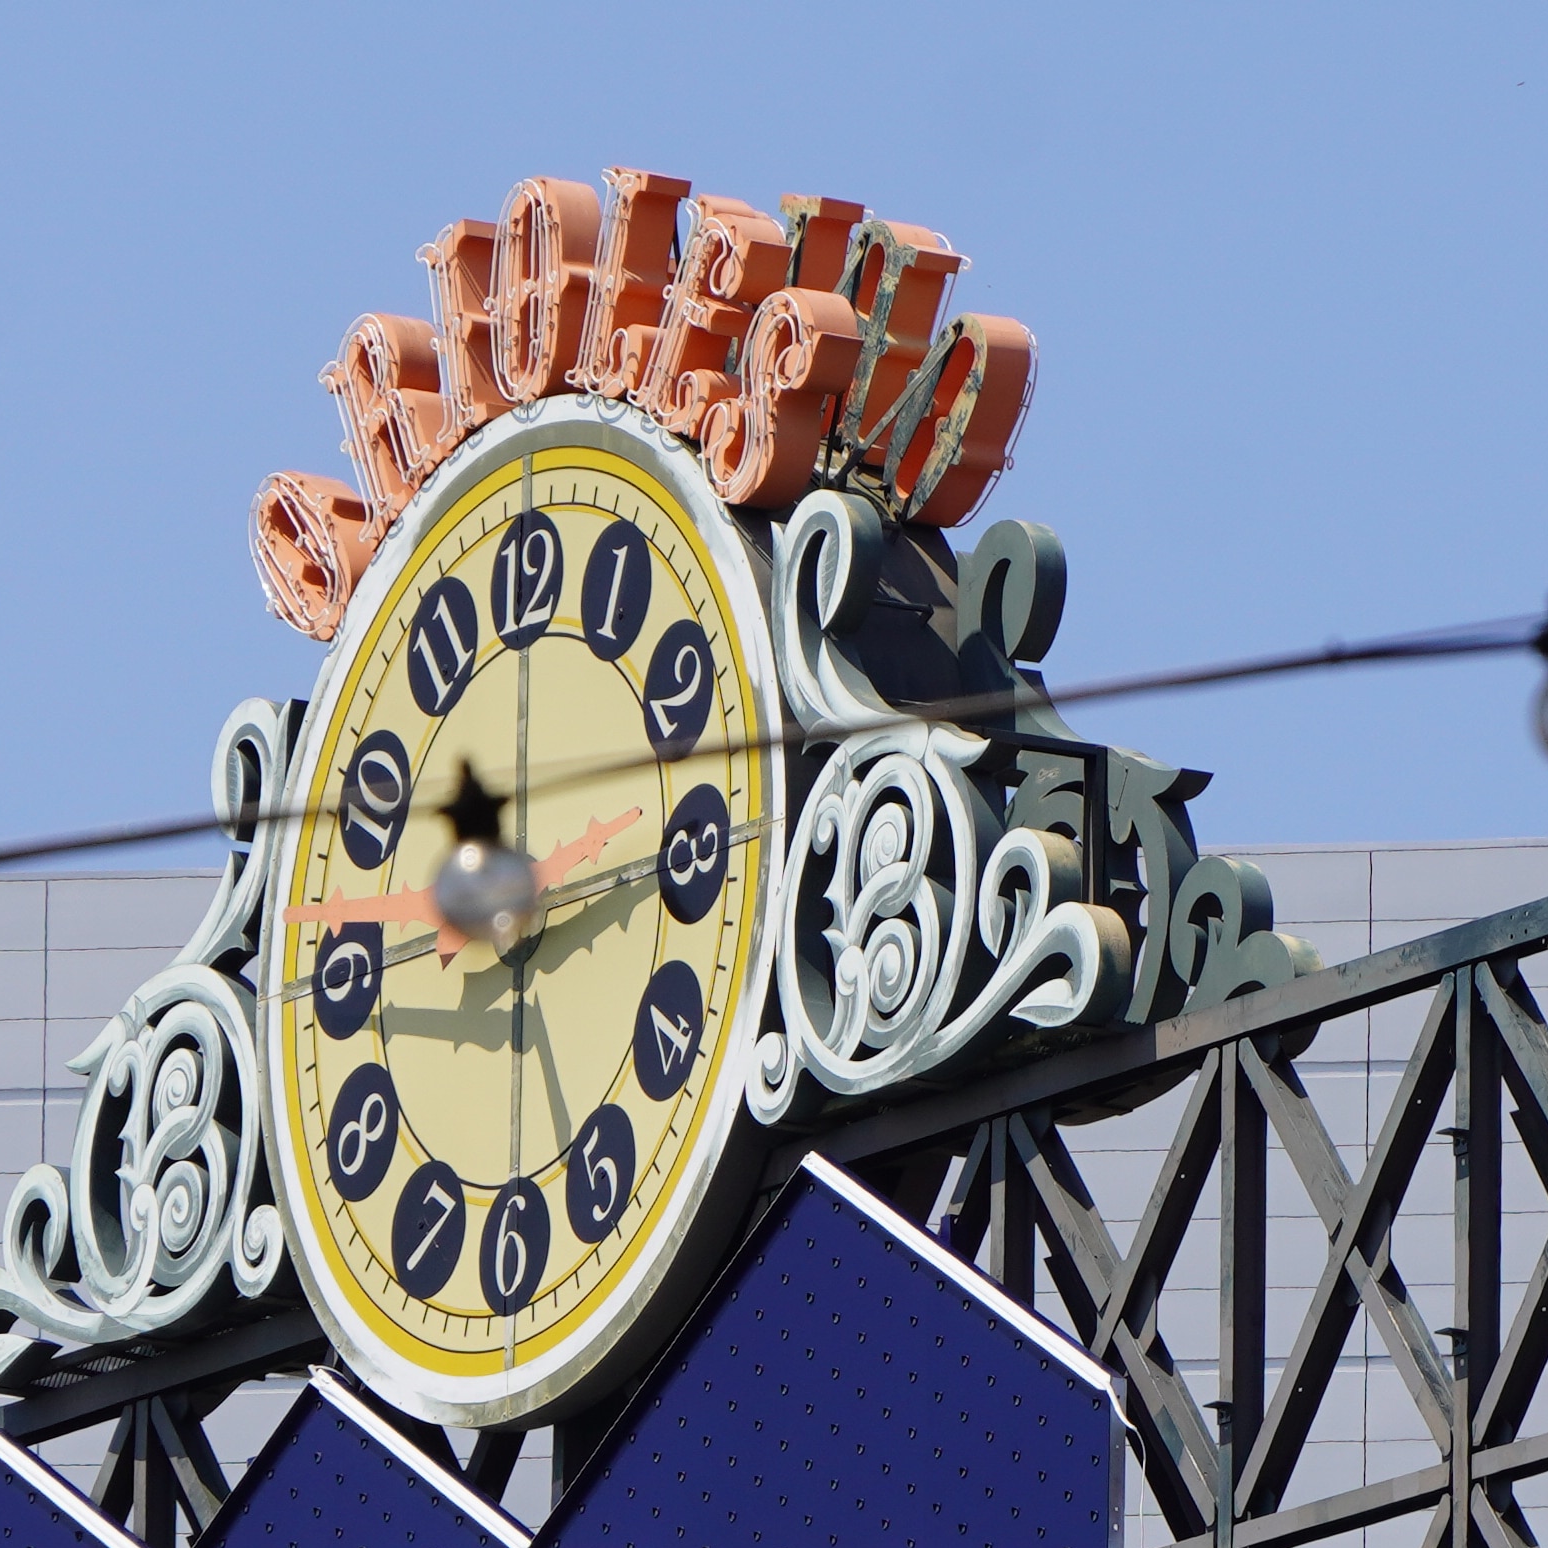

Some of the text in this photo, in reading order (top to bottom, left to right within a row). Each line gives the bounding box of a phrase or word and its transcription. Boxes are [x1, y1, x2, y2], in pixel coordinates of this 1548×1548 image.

[249, 166, 863, 641] ORIOLES
[499, 528, 556, 637] 12
[596, 545, 628, 640] 1
[412, 595, 474, 711] 11
[649, 645, 702, 739] 2
[345, 750, 403, 860] 10
[666, 821, 719, 887] 3
[321, 941, 372, 1002] 9
[649, 1004, 693, 1077] 4
[337, 1092, 388, 1176] 8
[582, 1125, 619, 1222] 5
[406, 1179, 457, 1271] 7
[495, 1194, 527, 1297] 6
